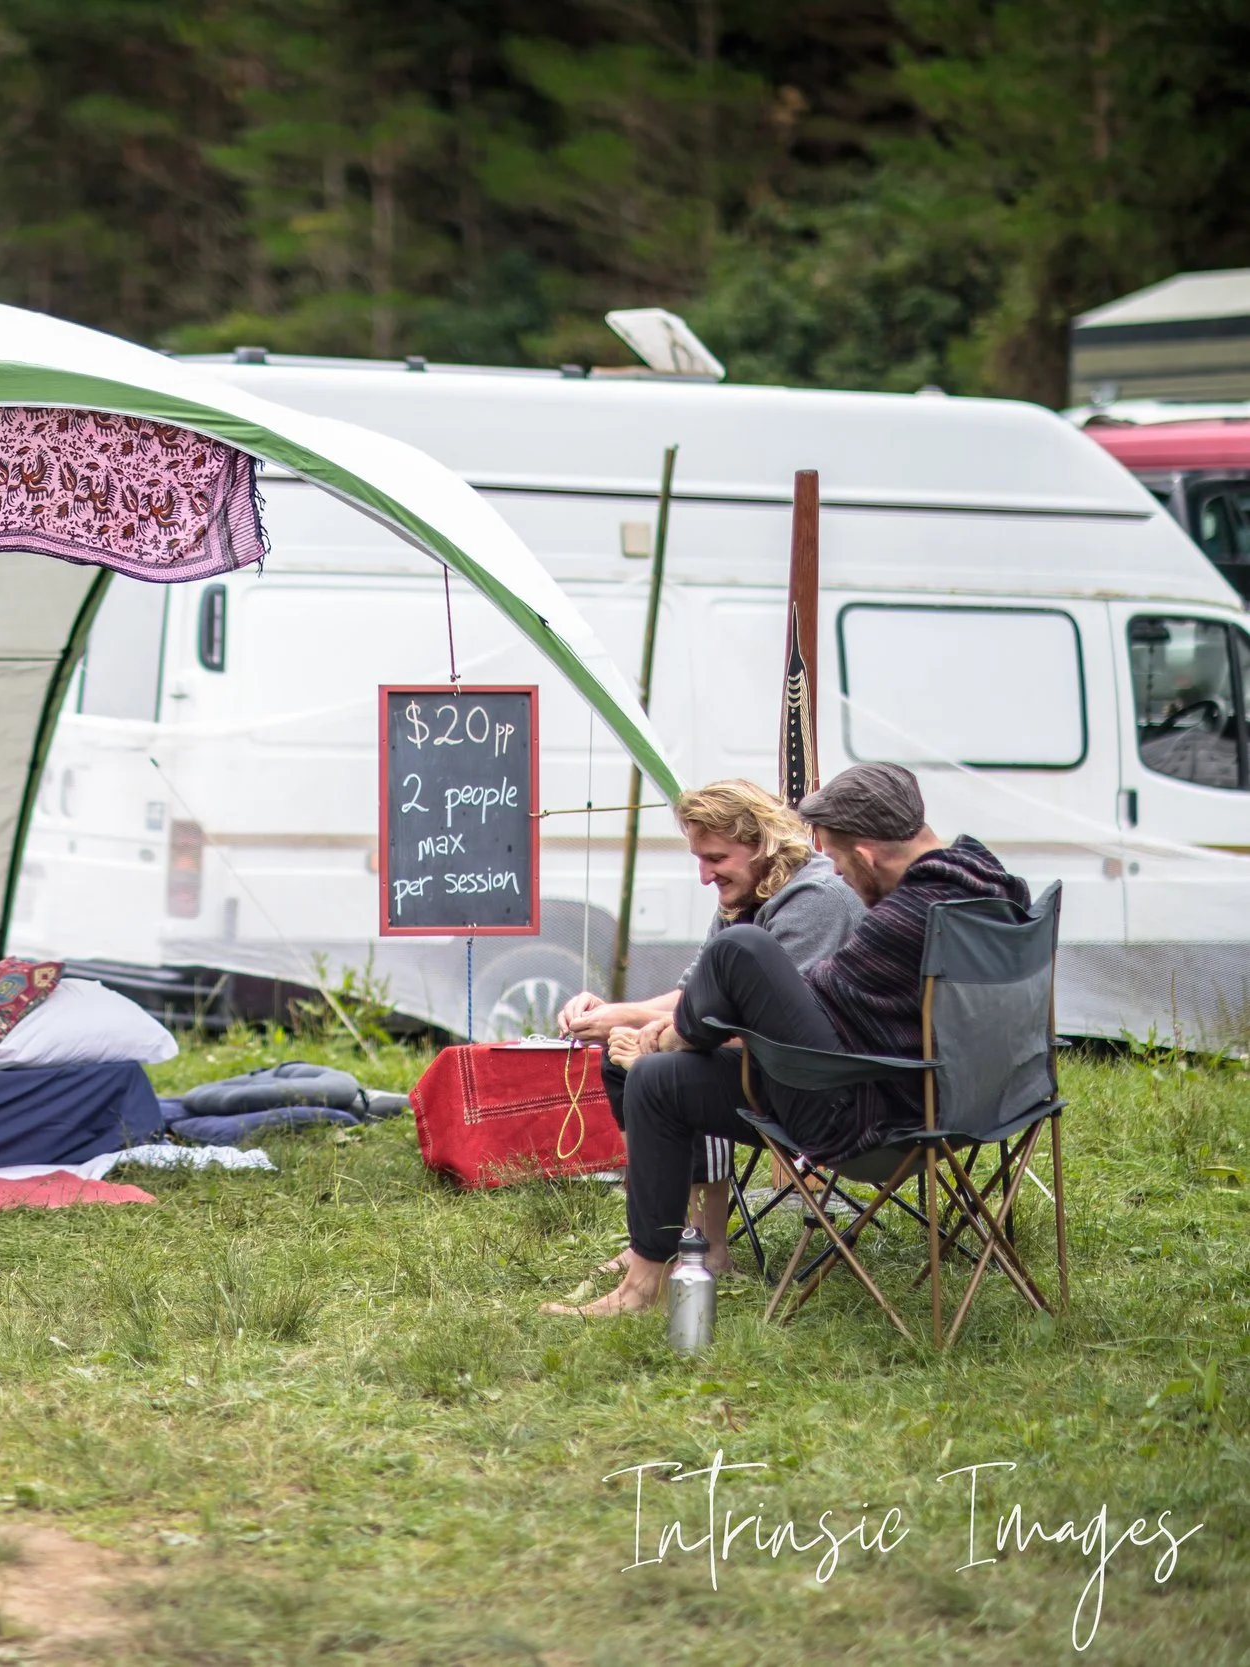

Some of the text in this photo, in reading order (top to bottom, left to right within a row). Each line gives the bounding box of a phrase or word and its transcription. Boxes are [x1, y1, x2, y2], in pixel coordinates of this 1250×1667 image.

[401, 773, 518, 828] 2 people
[417, 833, 466, 862] max
[393, 867, 520, 916] per session
